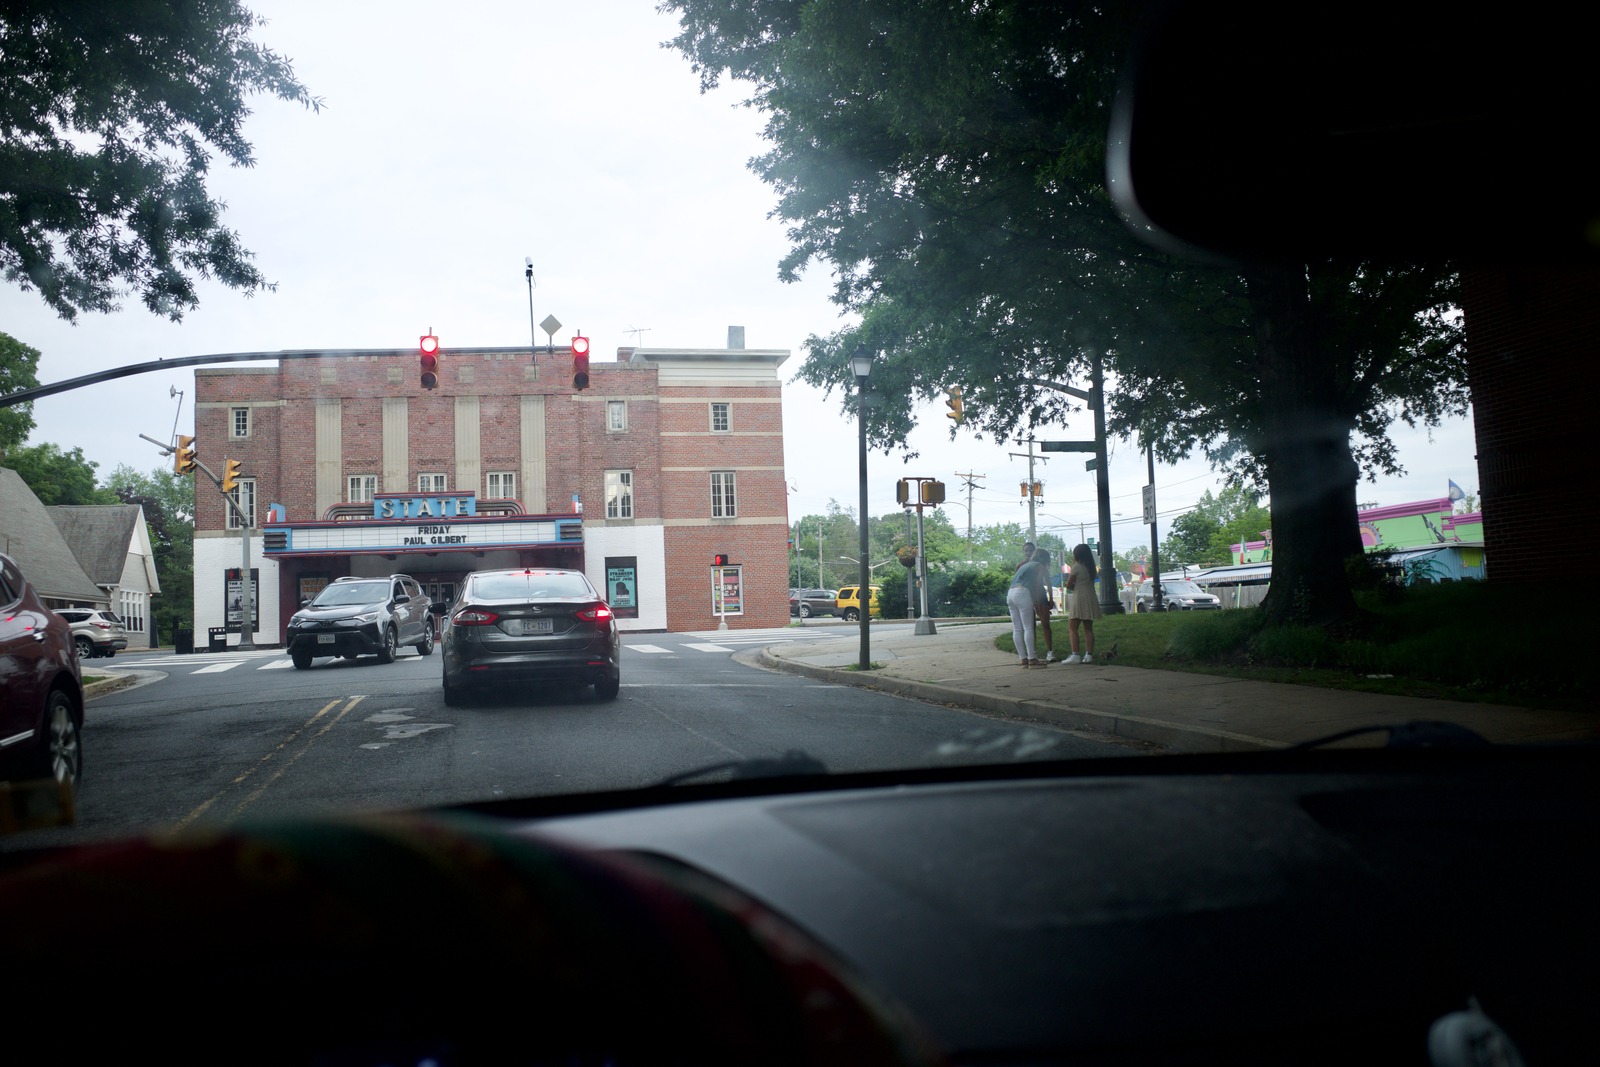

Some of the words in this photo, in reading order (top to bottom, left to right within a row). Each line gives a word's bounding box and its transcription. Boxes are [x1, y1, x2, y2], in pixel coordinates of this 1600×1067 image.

[381, 497, 469, 518] STATE
[1144, 505, 1154, 520] 30
[418, 525, 451, 535] FRIDAY
[403, 536, 426, 546] PAUL
[430, 535, 467, 545] GILBERT
